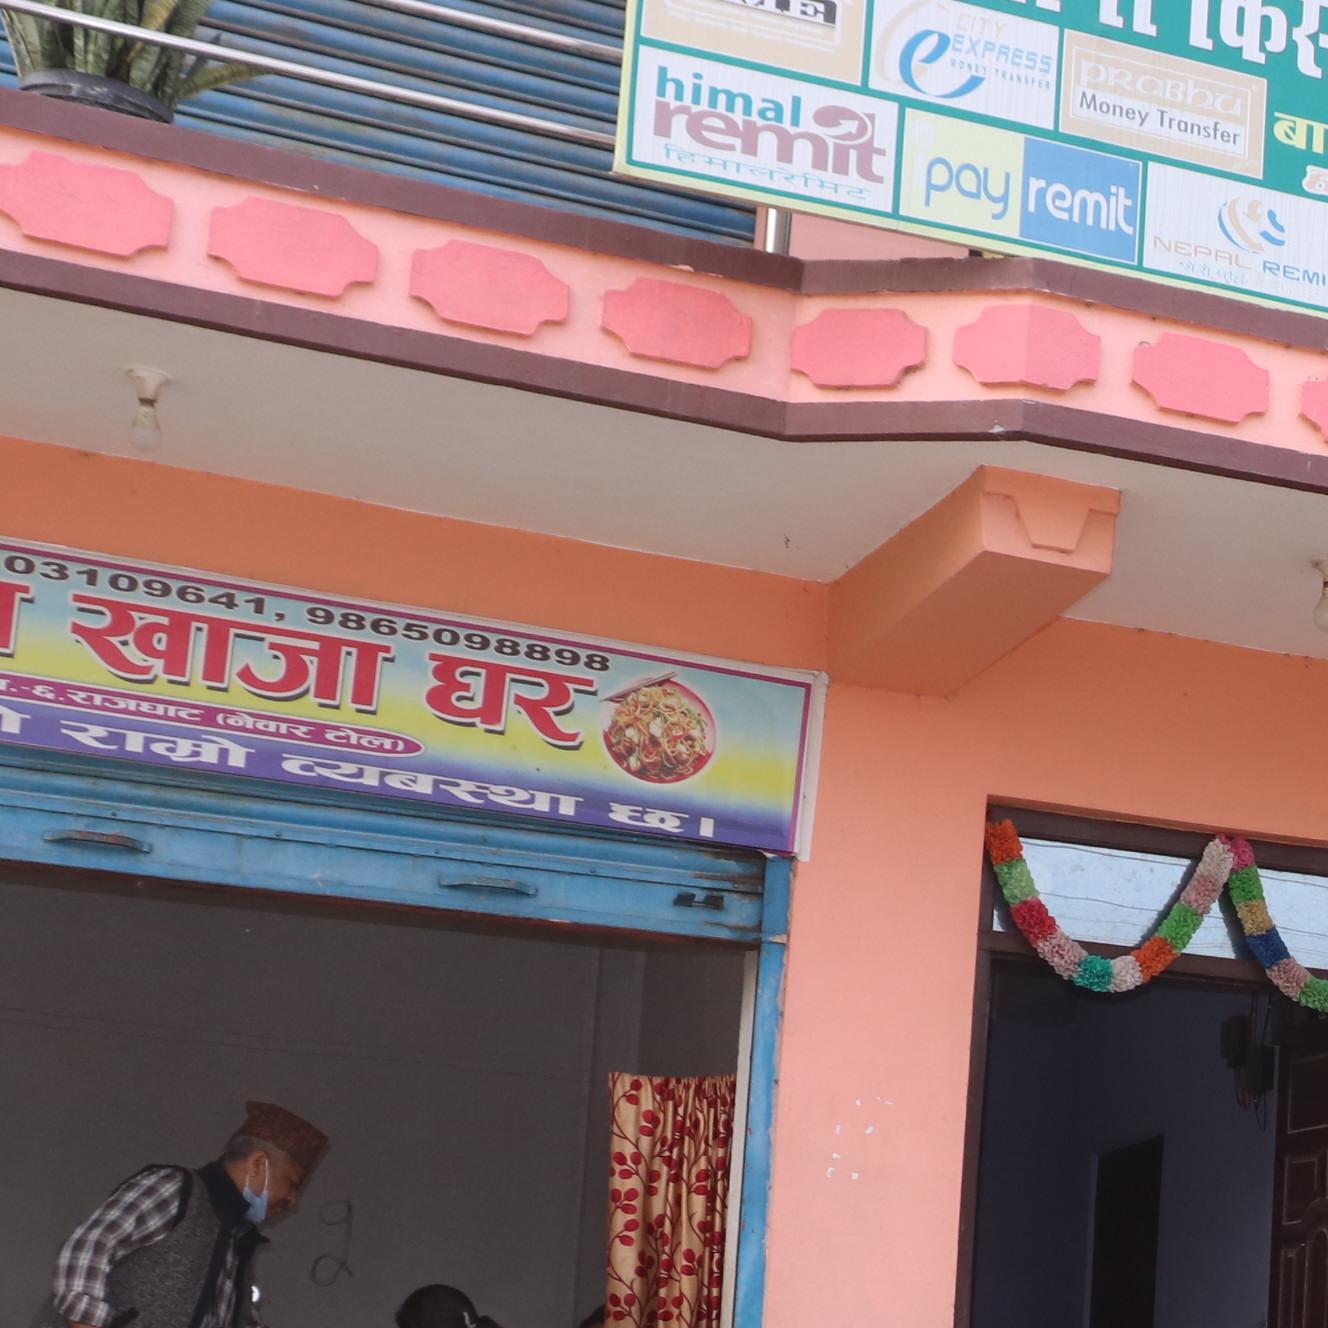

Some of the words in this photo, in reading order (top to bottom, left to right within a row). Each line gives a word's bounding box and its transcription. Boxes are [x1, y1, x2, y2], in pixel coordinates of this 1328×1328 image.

[956, 12, 1008, 39] CITY
[950, 58, 988, 76] MONEY
[994, 67, 1051, 90] TRANSFER
[951, 33, 1054, 75] EXPRESS
[656, 65, 802, 128] himal
[1079, 91, 1149, 128] Money
[1156, 108, 1241, 145] Transfer
[653, 97, 886, 184] remit
[1026, 172, 1133, 235] remit
[1152, 235, 1252, 270] NEPAL
[306, 605, 611, 672] 9865098898
[70, 592, 394, 713] खाजा
[424, 651, 598, 751] घर
[60, 719, 256, 768] राम्रो
